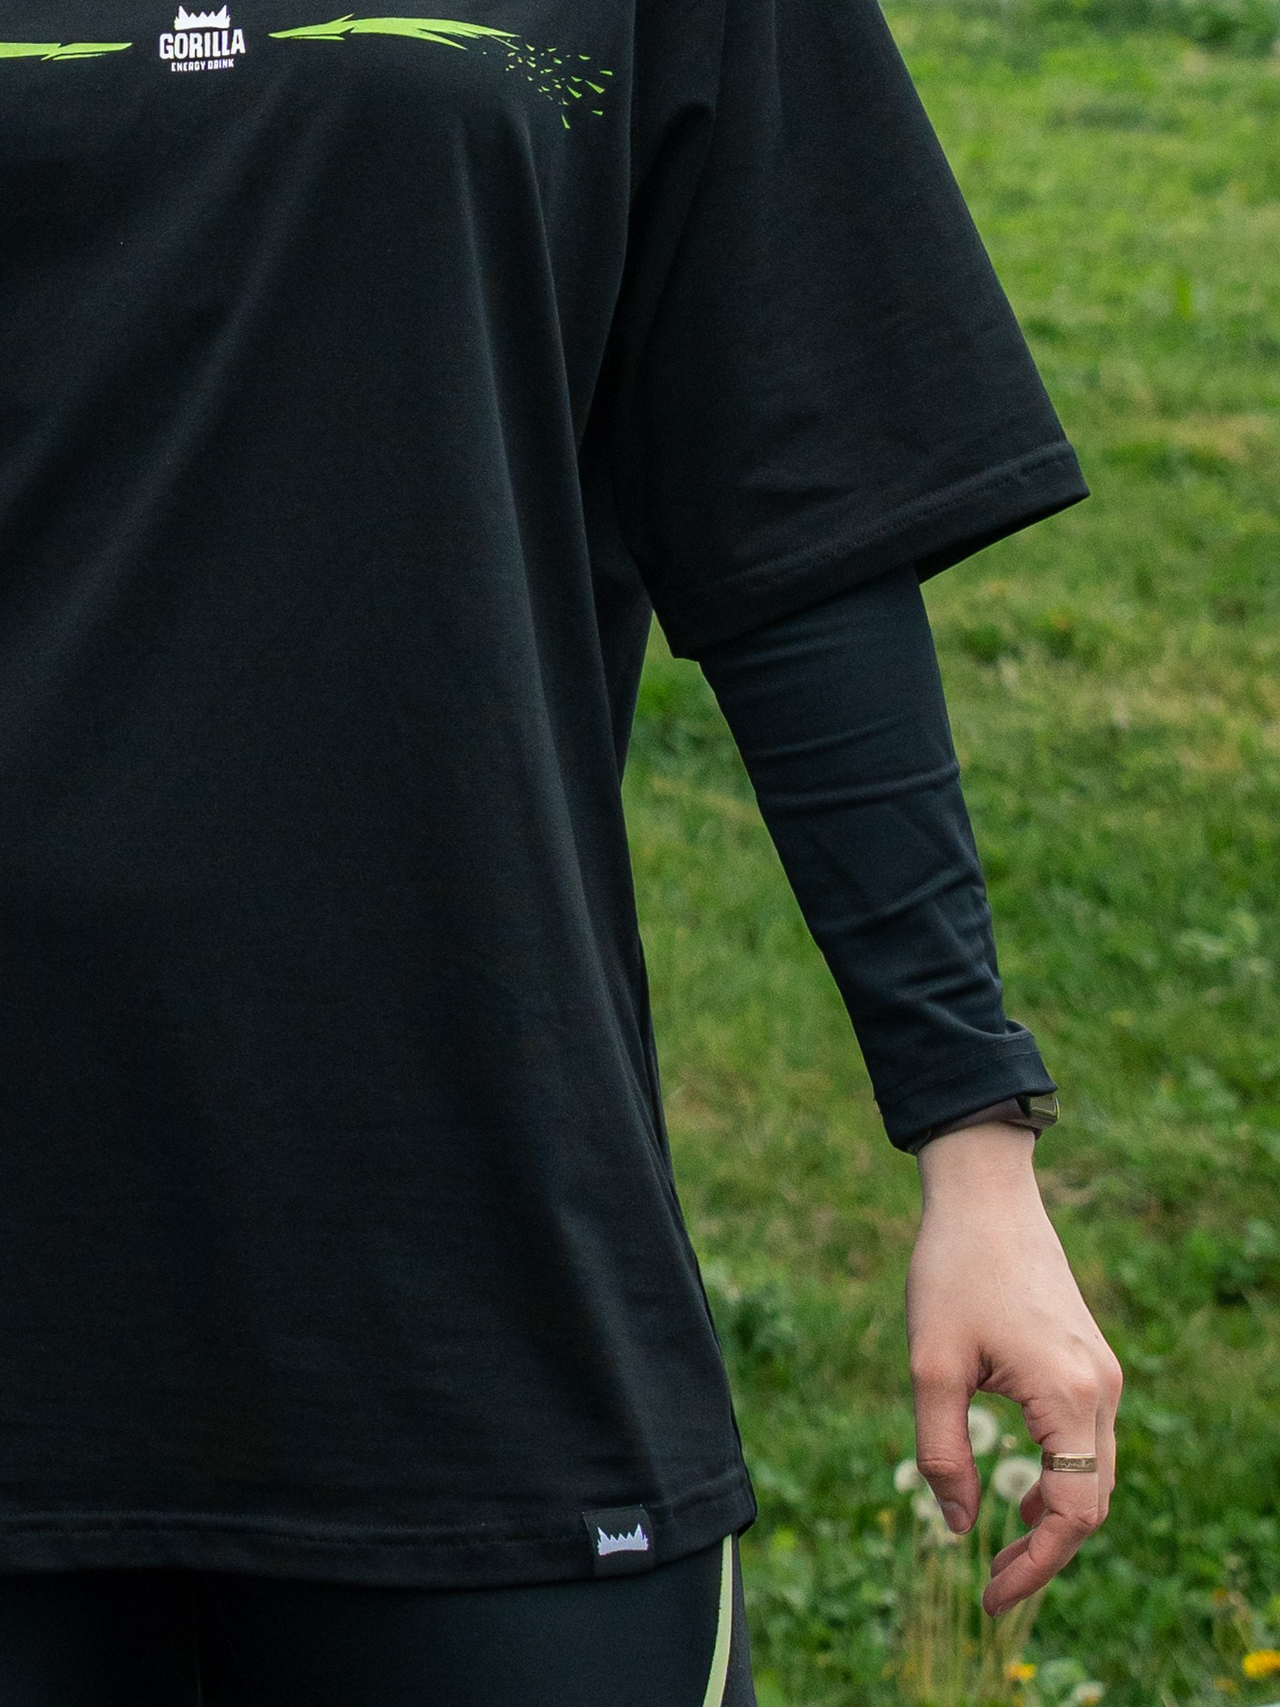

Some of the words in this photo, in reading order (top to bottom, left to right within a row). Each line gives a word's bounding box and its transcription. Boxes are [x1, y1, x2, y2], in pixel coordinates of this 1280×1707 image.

[159, 28, 246, 60] GORILLA
[171, 61, 206, 72] ENERGY
[207, 58, 235, 70] DRINK
